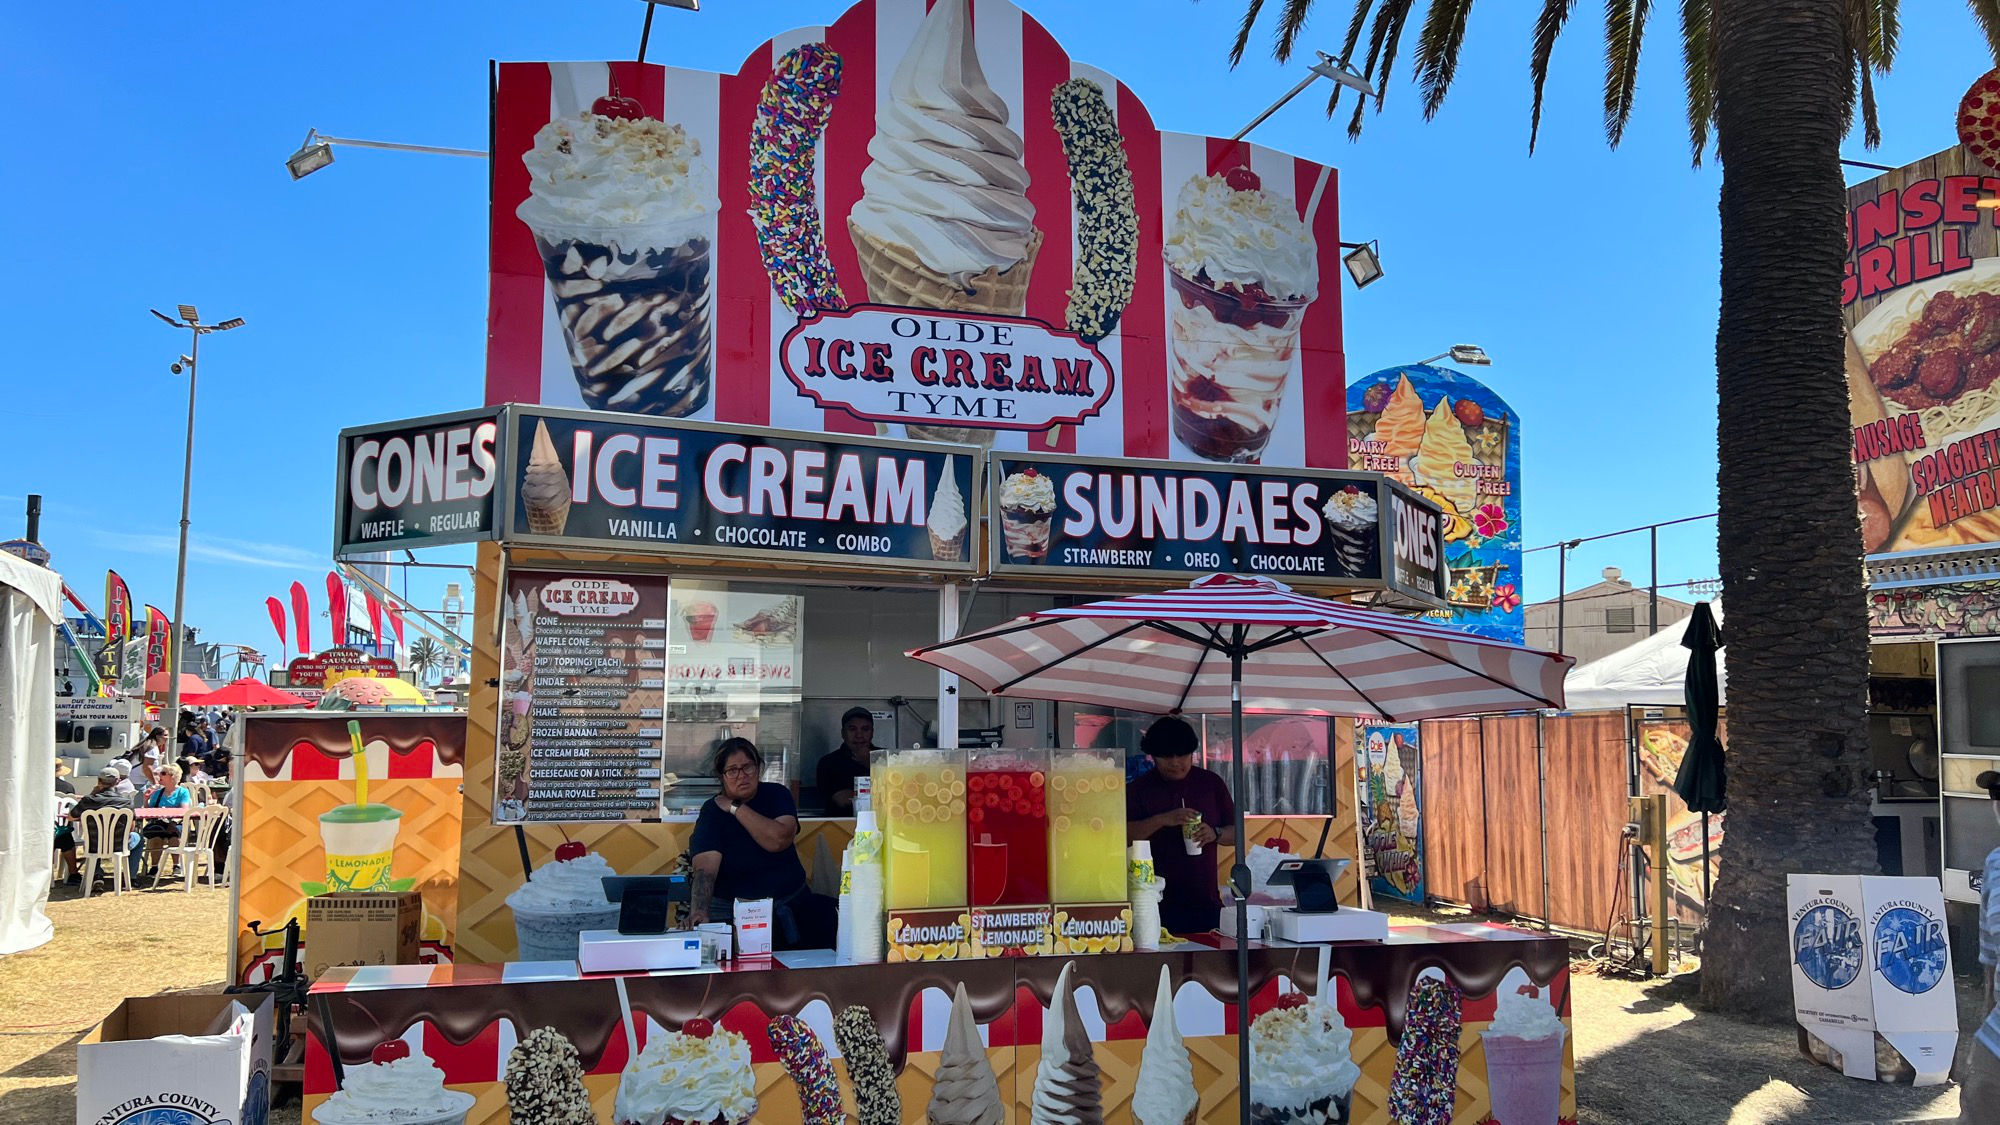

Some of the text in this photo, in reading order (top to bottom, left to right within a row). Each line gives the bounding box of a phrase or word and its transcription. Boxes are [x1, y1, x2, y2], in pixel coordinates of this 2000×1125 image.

[890, 316, 1014, 347] OLDE
[803, 336, 1095, 397] ICE CREAM
[887, 390, 1018, 420] TYME
[1852, 411, 1926, 464] AUSAGE
[1350, 437, 1387, 456] DAIRY
[350, 421, 497, 511] CONES
[1363, 454, 1400, 472] FREE!
[1453, 460, 1500, 481] GLUTEN
[571, 429, 926, 527] ICE CREAM
[1476, 479, 1511, 497] FREE!
[1062, 470, 1323, 547] SUNDAES
[360, 510, 481, 540] WAFFLE REGULAR
[608, 518, 892, 554] VANILLA CHOCOLATE COMBO
[1063, 548, 1326, 573] STRAWBERRY OREO CHOCOLATE
[571, 580, 610, 590] OLDE
[546, 589, 635, 606] ICE CREAM
[569, 605, 610, 615] TYME
[535, 616, 558, 626] CONE
[585, 628, 605, 636] Combo
[535, 636, 590, 646] WAFFLE CONE
[584, 647, 604, 655] Combo
[534, 657, 622, 668] DIP TOPPINGS (EACH)
[603, 668, 628, 677] Sprinkles
[533, 677, 565, 686] SUNDAE
[532, 707, 558, 717] SHAKE
[553, 699, 571, 707] Peanut
[602, 699, 619, 709] Fudge
[531, 728, 598, 737] FROZEN BANANA
[530, 748, 590, 757] ICE CREAM BAR
[626, 739, 651, 749] sprinkles
[603, 760, 618, 768] toffee
[626, 760, 650, 769] sprinkles
[529, 769, 622, 778] CHEESECAKE ON A STICK
[529, 780, 547, 788] Rolled
[602, 780, 618, 788] toffee
[625, 780, 650, 790] sprinkles
[528, 789, 596, 799] BANANA ROYALE
[570, 811, 583, 819] whip
[606, 811, 624, 819] cherry
[335, 856, 385, 868] LEMONADE
[1792, 897, 1855, 922] VENTURA COUNTY
[1870, 900, 1936, 925] VENTURA COUNTY
[971, 911, 1051, 929] STRAWBERRY
[1060, 919, 1126, 937] LEMONADE
[895, 924, 965, 944] LEMONADE
[980, 930, 1044, 946] LEMONADE
[1874, 919, 1948, 971] FAIR
[95, 1092, 221, 1125] ENTURA COUNTY
